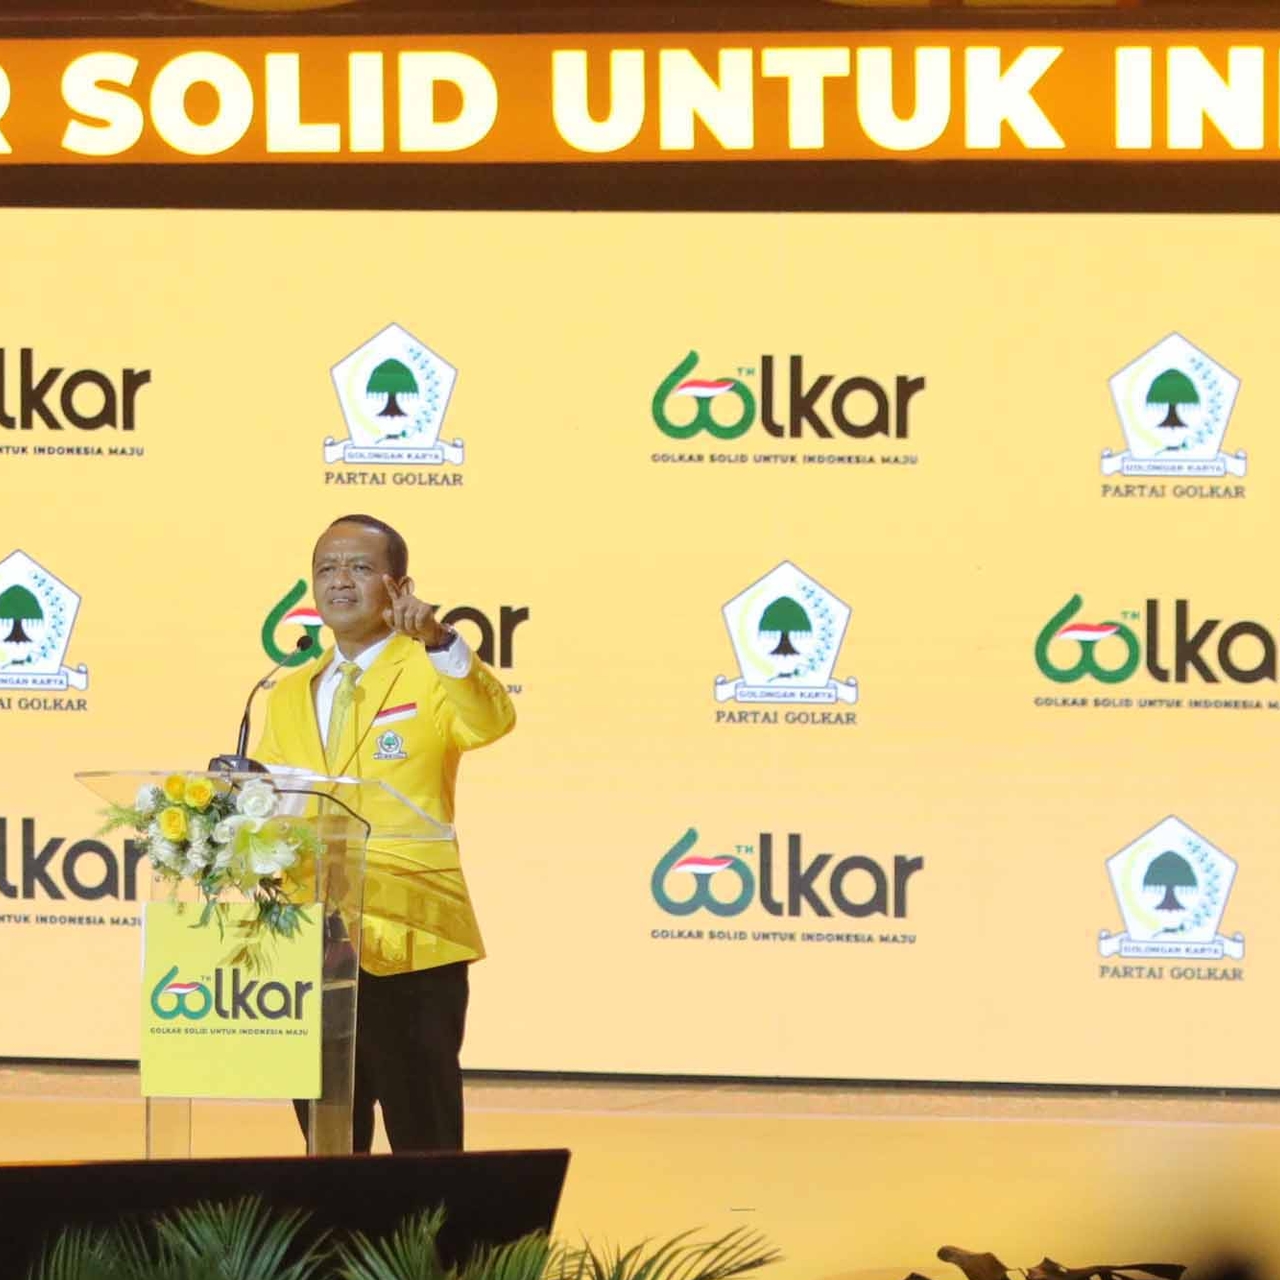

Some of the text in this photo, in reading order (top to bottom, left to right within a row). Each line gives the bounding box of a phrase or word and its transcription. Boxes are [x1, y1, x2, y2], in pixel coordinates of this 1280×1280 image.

[61, 51, 498, 155] SOLID
[552, 46, 1066, 153] UNTUK
[324, 471, 464, 486] PARTAI GOLKAR
[1101, 484, 1246, 499] PARTAI GOLKAR
[17, 698, 88, 711] GOLKAR
[715, 710, 857, 725] PARTAI GOLKAR
[1099, 965, 1243, 980] PARTAI GOLKAR
